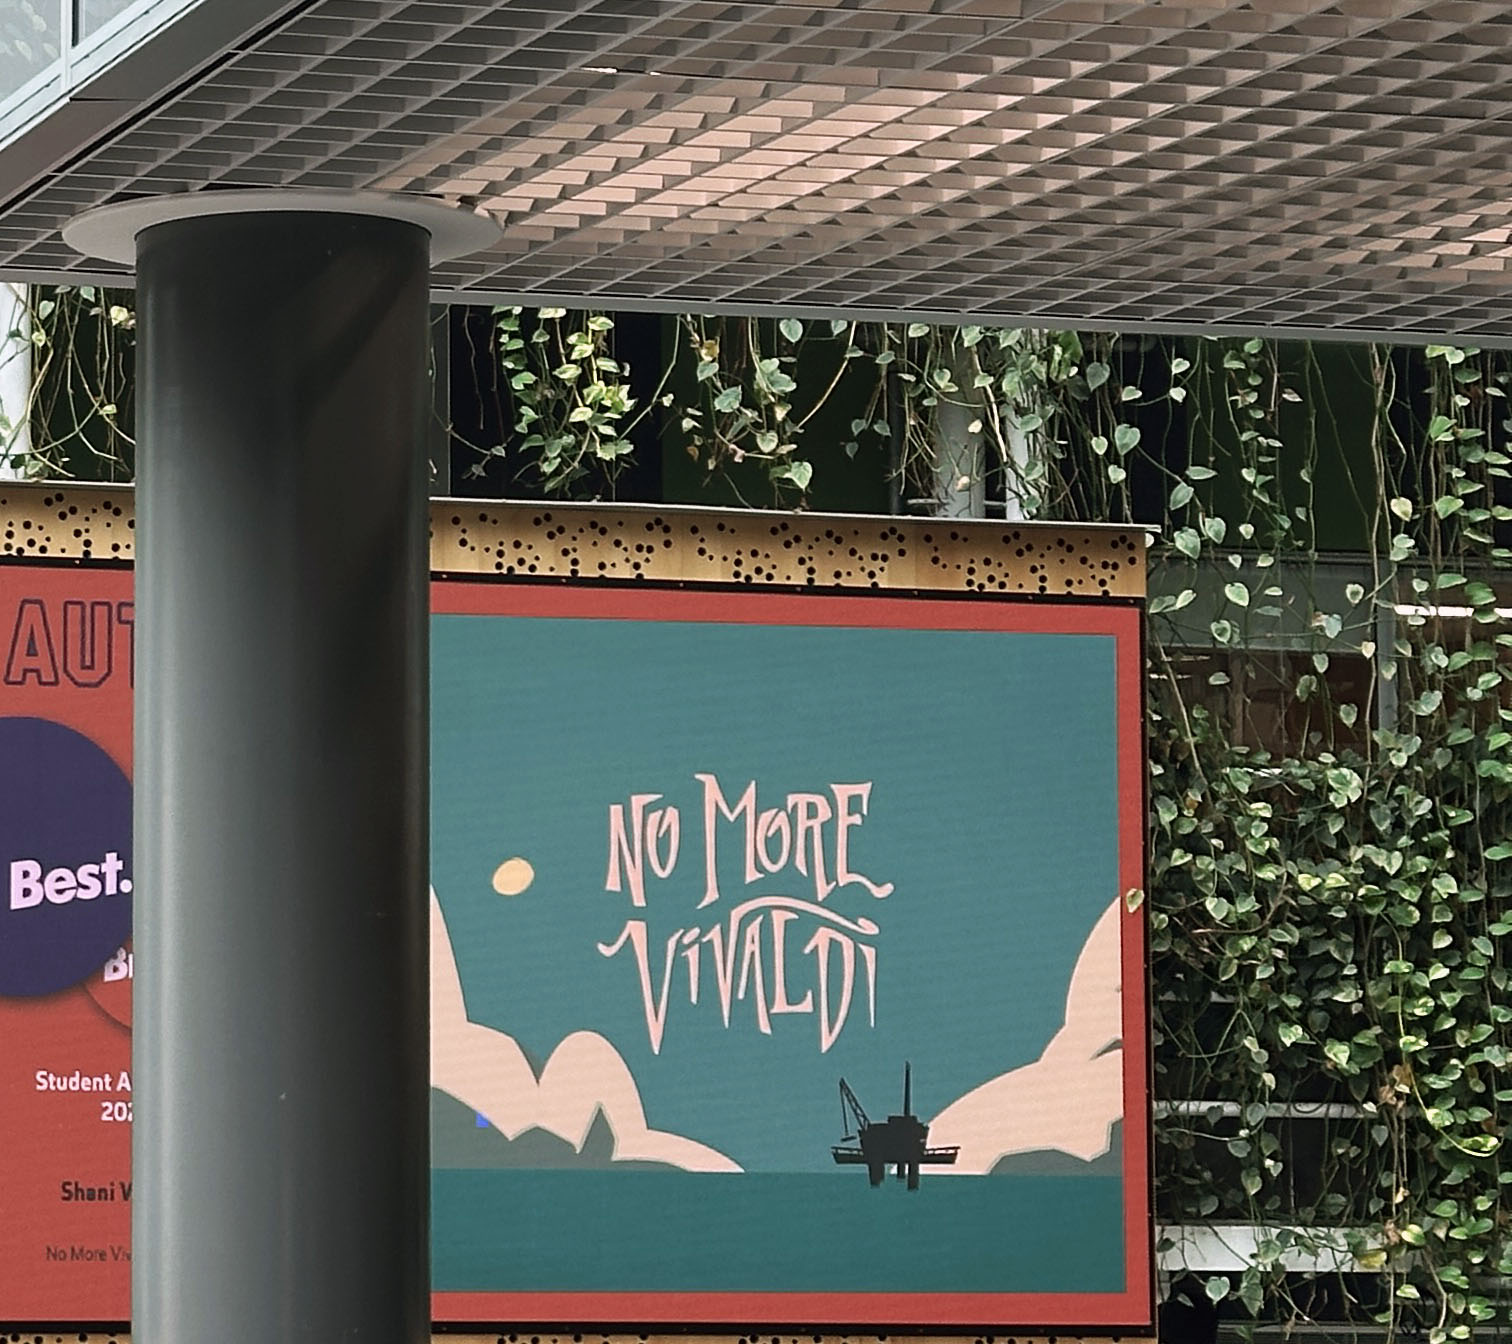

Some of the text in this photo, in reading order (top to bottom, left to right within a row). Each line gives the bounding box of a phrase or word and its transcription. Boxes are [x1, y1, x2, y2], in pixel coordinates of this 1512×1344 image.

[605, 772, 895, 910] NO MORE
[10, 851, 133, 910] Best.
[35, 1070, 111, 1091] Student
[61, 1181, 115, 1201] Shani
[45, 1245, 67, 1261] No
[70, 1245, 107, 1262] More
